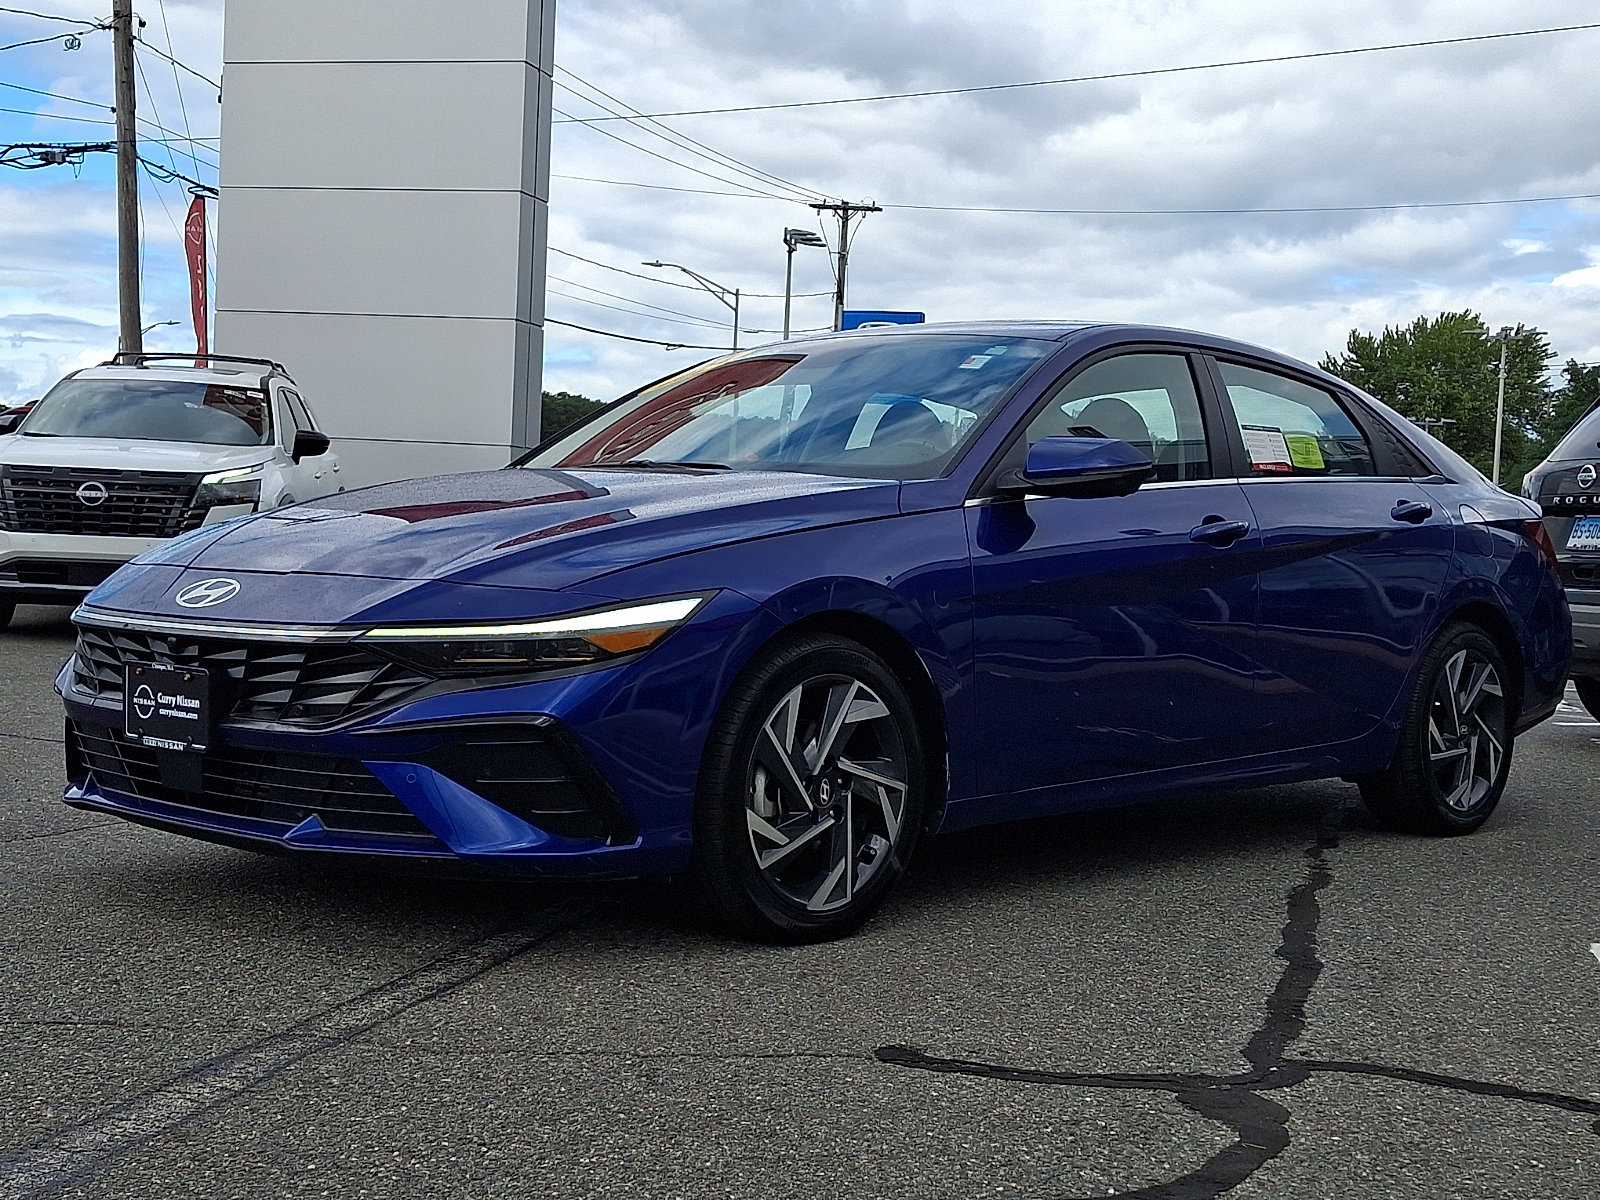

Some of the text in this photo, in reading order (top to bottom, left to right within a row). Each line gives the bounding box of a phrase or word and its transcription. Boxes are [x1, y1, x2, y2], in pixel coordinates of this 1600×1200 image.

[133, 696, 156, 707] NISSAN
[157, 692, 201, 709] Curry Nissan
[157, 740, 185, 752] NISSAN
